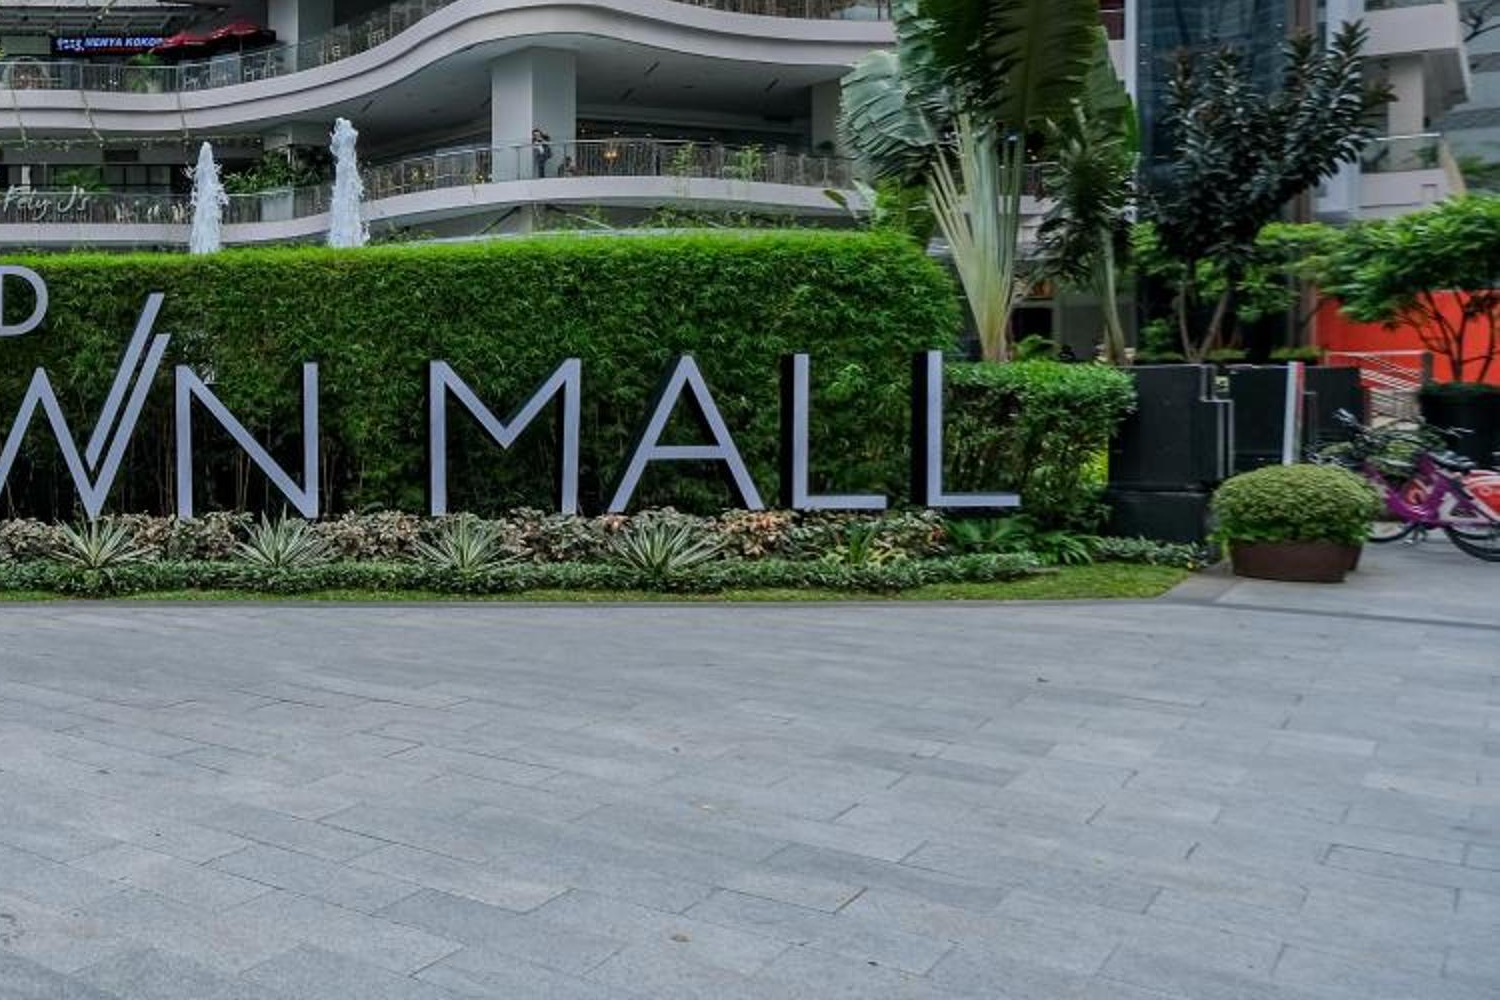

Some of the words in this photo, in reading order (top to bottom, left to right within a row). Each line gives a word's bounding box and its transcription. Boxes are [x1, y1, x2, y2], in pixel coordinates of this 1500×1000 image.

[3, 184, 52, 221] Fely
[57, 184, 91, 213] J's
[428, 349, 1022, 518] MALL
